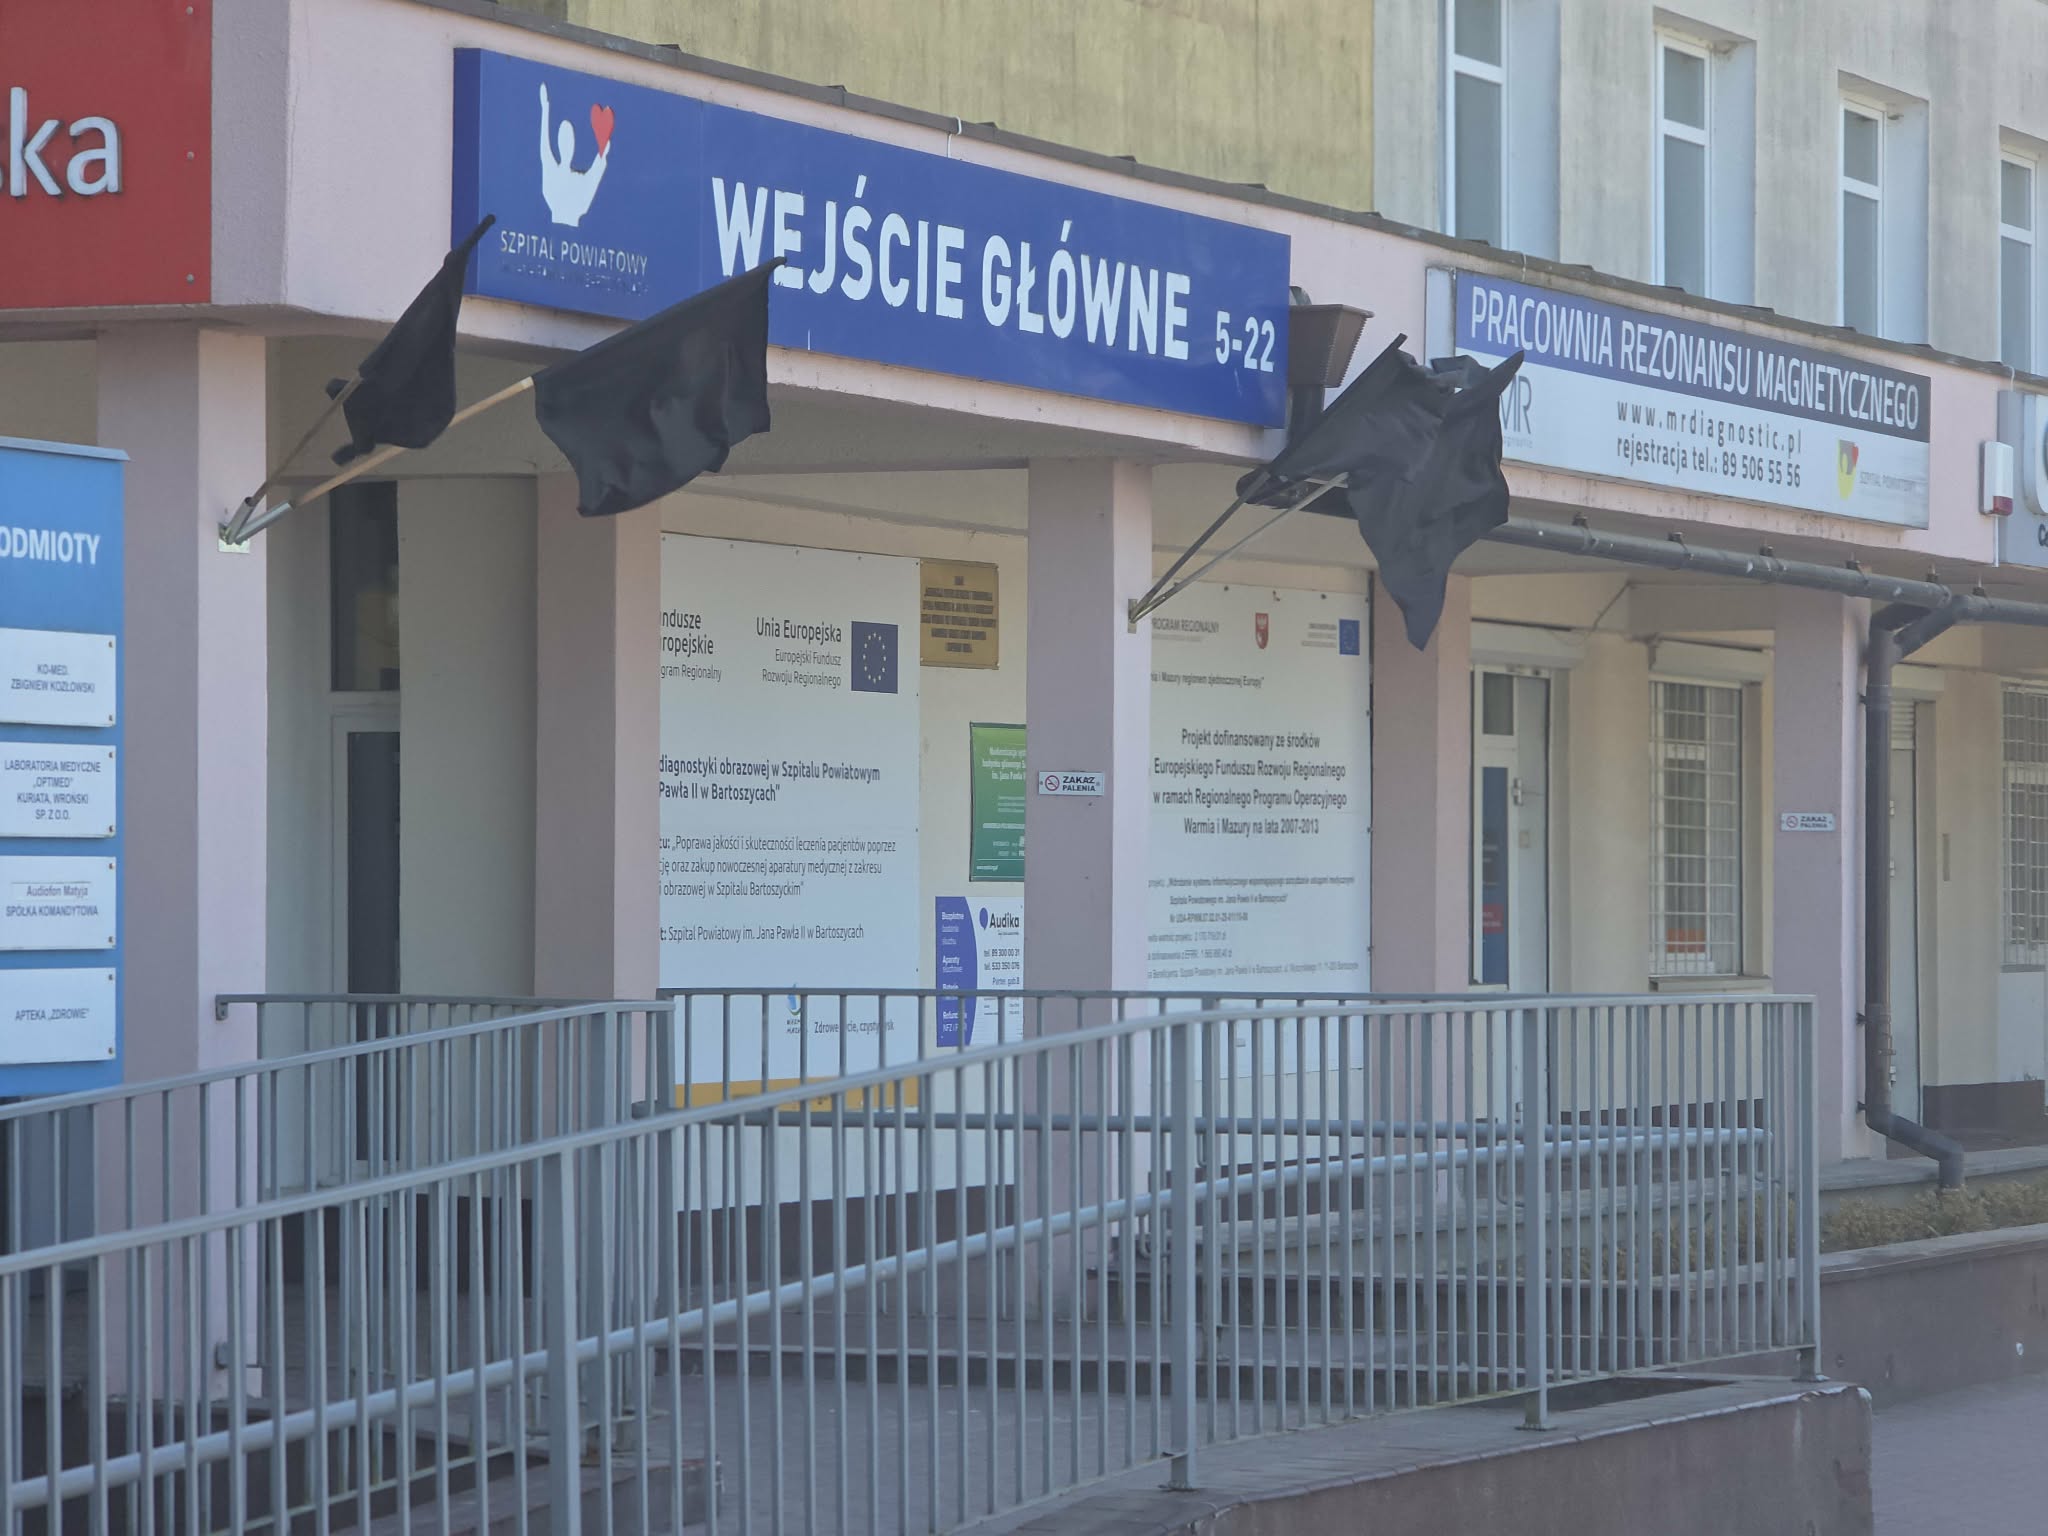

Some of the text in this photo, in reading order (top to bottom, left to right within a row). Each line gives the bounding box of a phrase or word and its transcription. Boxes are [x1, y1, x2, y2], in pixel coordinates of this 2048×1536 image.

[0, 86, 122, 197] ka
[500, 230, 648, 276] SZPITAL POWIATOWY
[711, 174, 1276, 373] WEJŚCIE GŁÓWNE 5-22
[1471, 286, 1919, 430] PRACOWNIA REZONANSU MAGNETYCZNEGO
[1617, 400, 1801, 459] www.mrdiagnostic.pl
[1617, 433, 1801, 488] rejestracja tel.: 89 506 55 56
[660, 609, 701, 630] ndusze
[756, 617, 842, 645] Unia Europejska
[660, 633, 714, 658] ropejskie
[775, 649, 841, 666] Europejski Fundusz
[681, 664, 722, 682] Regionalny
[762, 669, 841, 688] Rozwoju Regionalnego
[1181, 729, 1320, 751] Projekt dofinansowany ze środków
[659, 754, 881, 784] diagnostyki obrazowej w Szpitalu Powiatowym
[1154, 757, 1346, 781] Europejskiego Funduszu Rozwoju Regionalnego
[659, 781, 689, 799] Pawła
[701, 787, 709, 799] w
[1062, 776, 1095, 784] ZAKAZ
[1062, 784, 1096, 792] PALENIA
[1153, 788, 1347, 809] w ramach Regionalnego Programu Operacyjnego
[1184, 818, 1215, 834] Warmia
[1222, 818, 1250, 838] Mazury
[1252, 823, 1262, 834] na
[1264, 819, 1279, 834] lata
[712, 835, 740, 852] jakości
[745, 836, 794, 850] skuteczności
[796, 837, 826, 851] leczenia
[828, 838, 866, 855] pacjentów
[867, 841, 896, 855] poprzez
[671, 862, 689, 872] oraz
[690, 857, 715, 876] zakup
[717, 860, 767, 876] nowoczesnej
[768, 861, 805, 876] aparatury
[807, 860, 847, 876] medycznej
[854, 860, 882, 873] zakresu
[663, 880, 706, 899] obrazowej
[708, 884, 715, 895] w
[716, 881, 748, 899] Szpitalu
[990, 912, 1020, 929] Audika
[668, 925, 696, 944] Szpital
[697, 925, 741, 943] Powiatowy
[742, 925, 755, 940] im.
[756, 925, 774, 939] Jana
[776, 925, 799, 939] Pawła
[807, 929, 814, 939] w
[815, 924, 864, 941] Bartoszycach
